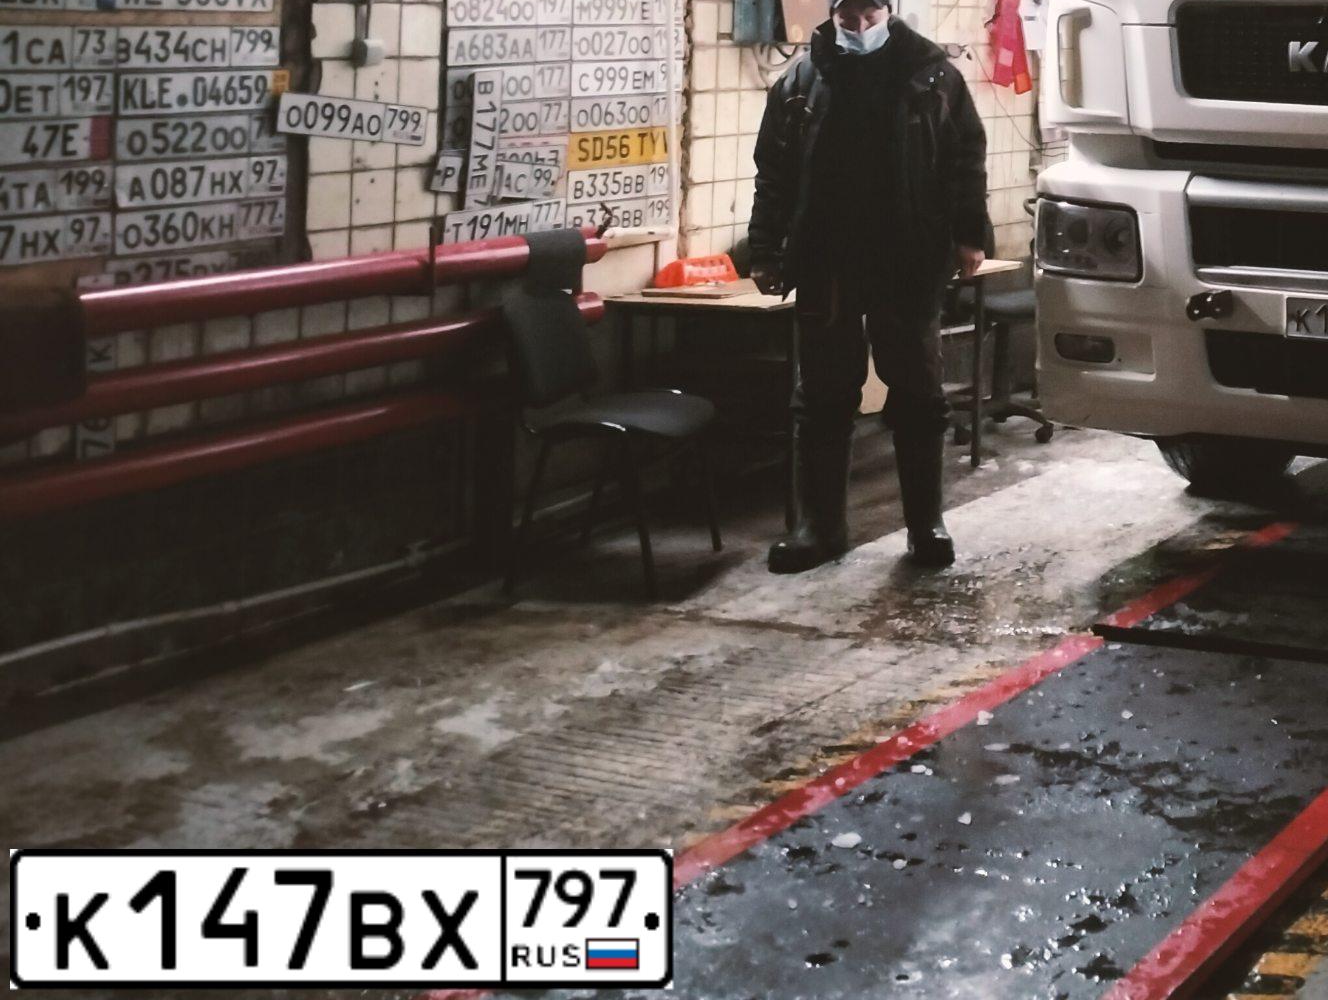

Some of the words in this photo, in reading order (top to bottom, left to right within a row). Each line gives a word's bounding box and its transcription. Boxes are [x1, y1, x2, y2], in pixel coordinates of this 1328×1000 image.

[77, 28, 106, 55] 73
[231, 29, 273, 53] 799
[62, 75, 107, 102] 197
[387, 107, 422, 132] 799
[578, 134, 631, 163] SD56
[129, 165, 243, 202] A087HX
[252, 159, 279, 184] 97
[573, 171, 645, 200] B335BB
[240, 202, 280, 226] 777
[534, 201, 561, 222] 777
[70, 216, 101, 245] 97
